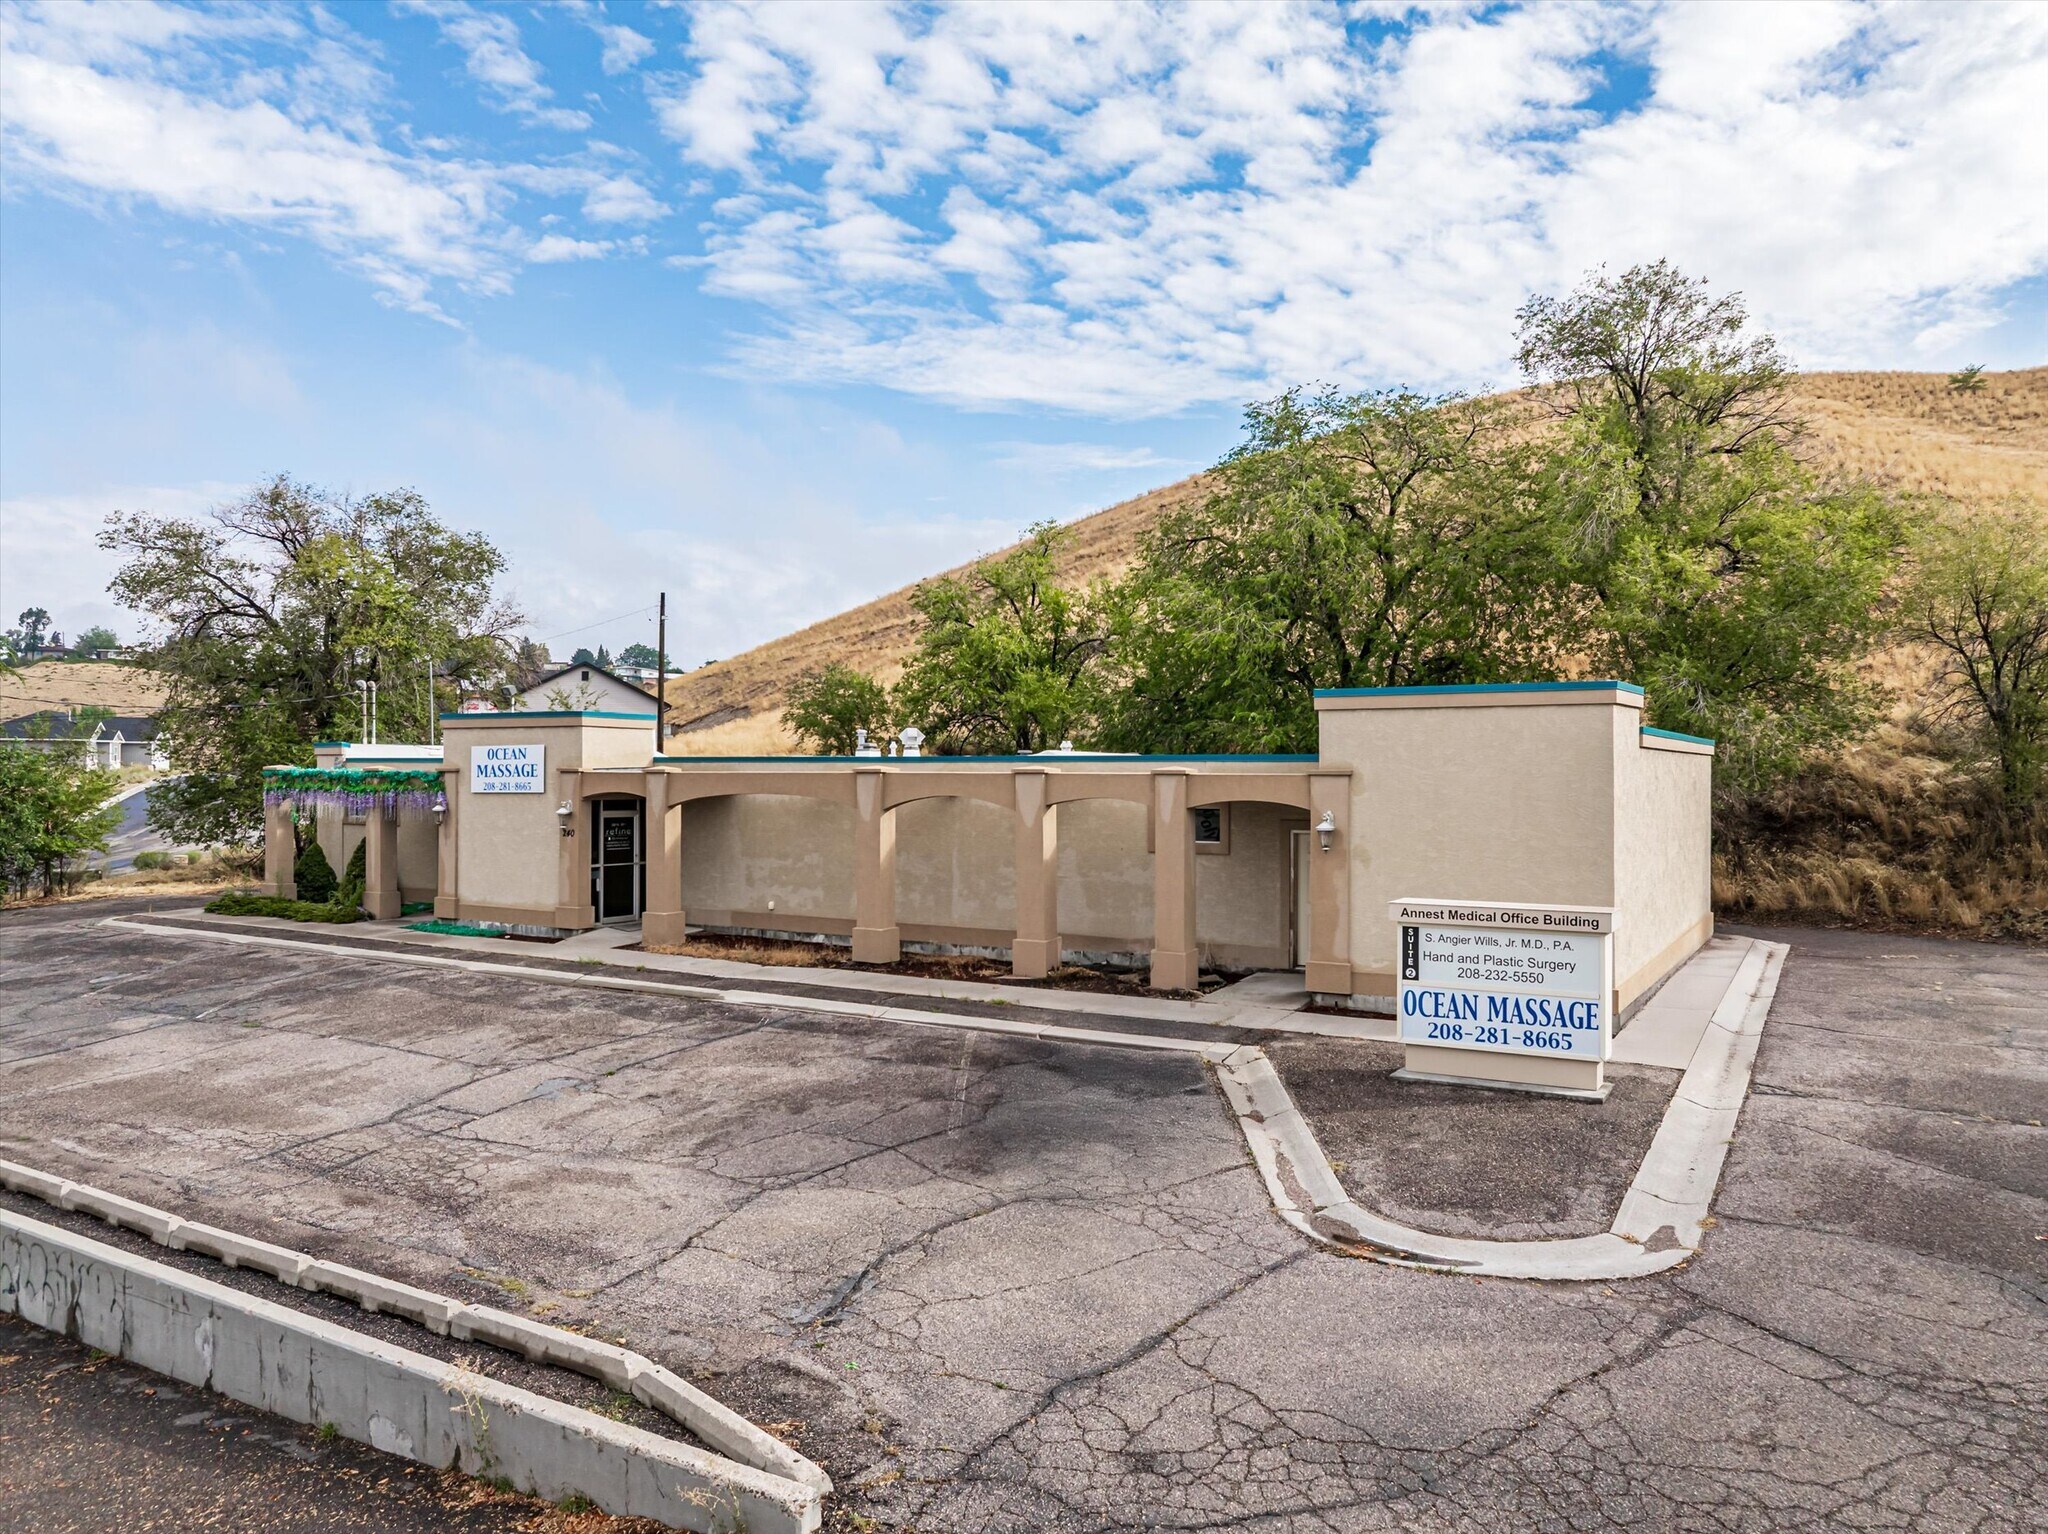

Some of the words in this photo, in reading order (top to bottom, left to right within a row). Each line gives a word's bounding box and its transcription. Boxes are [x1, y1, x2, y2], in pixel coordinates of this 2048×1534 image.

[487, 748, 527, 760] OCEAN
[477, 763, 538, 778] MASSAGE
[483, 782, 532, 791] 208-281-8665
[1400, 907, 1444, 920] Annest
[1448, 909, 1497, 923] Medical
[1500, 912, 1539, 925] Office
[1543, 915, 1600, 930] Building
[1424, 933, 1436, 943] S.
[1438, 934, 1472, 946] Angier
[1474, 936, 1502, 948] Wills,
[1505, 938, 1518, 948] Jr.
[1553, 940, 1575, 951] P.A.
[1423, 951, 1454, 963] Hand
[1457, 954, 1480, 965] and
[1484, 954, 1524, 967] Plastic
[1527, 957, 1577, 973] Surgery
[1457, 967, 1545, 984] 208-232-5550
[1403, 989, 1479, 1022] OCEAN
[1487, 995, 1600, 1031] MASSAGE
[1427, 1022, 1574, 1050] 208-281-8665
